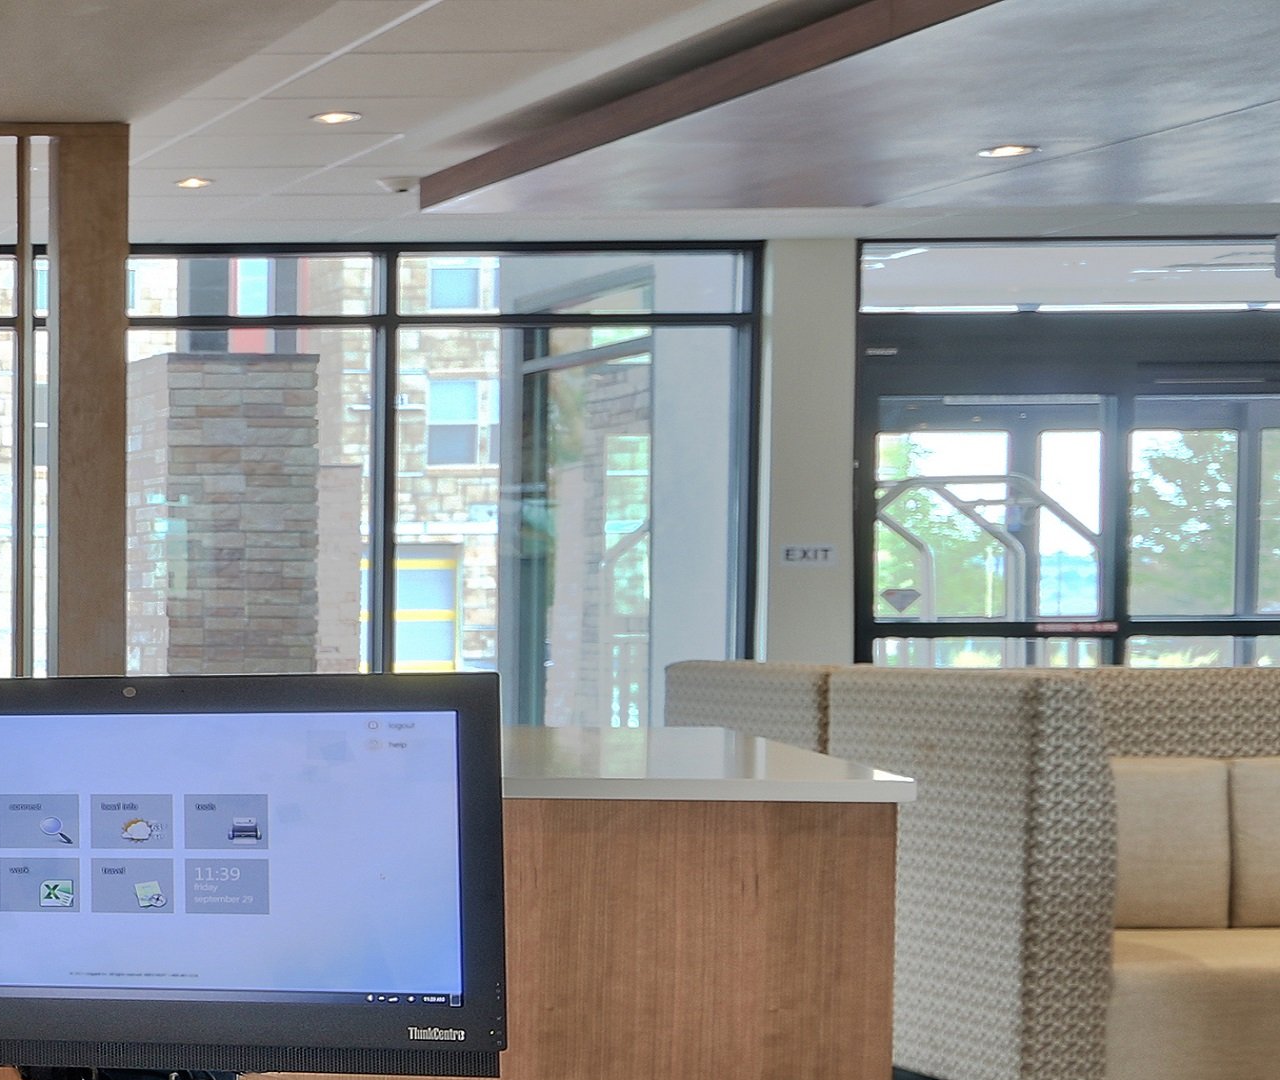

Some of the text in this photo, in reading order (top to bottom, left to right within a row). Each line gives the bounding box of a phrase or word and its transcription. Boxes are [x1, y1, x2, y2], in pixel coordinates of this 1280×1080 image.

[785, 549, 829, 561] EXIT
[194, 868, 240, 881] 11:39
[194, 883, 218, 893] friday
[194, 895, 254, 905] september 29
[408, 1027, 465, 1041] ThinkCentre
